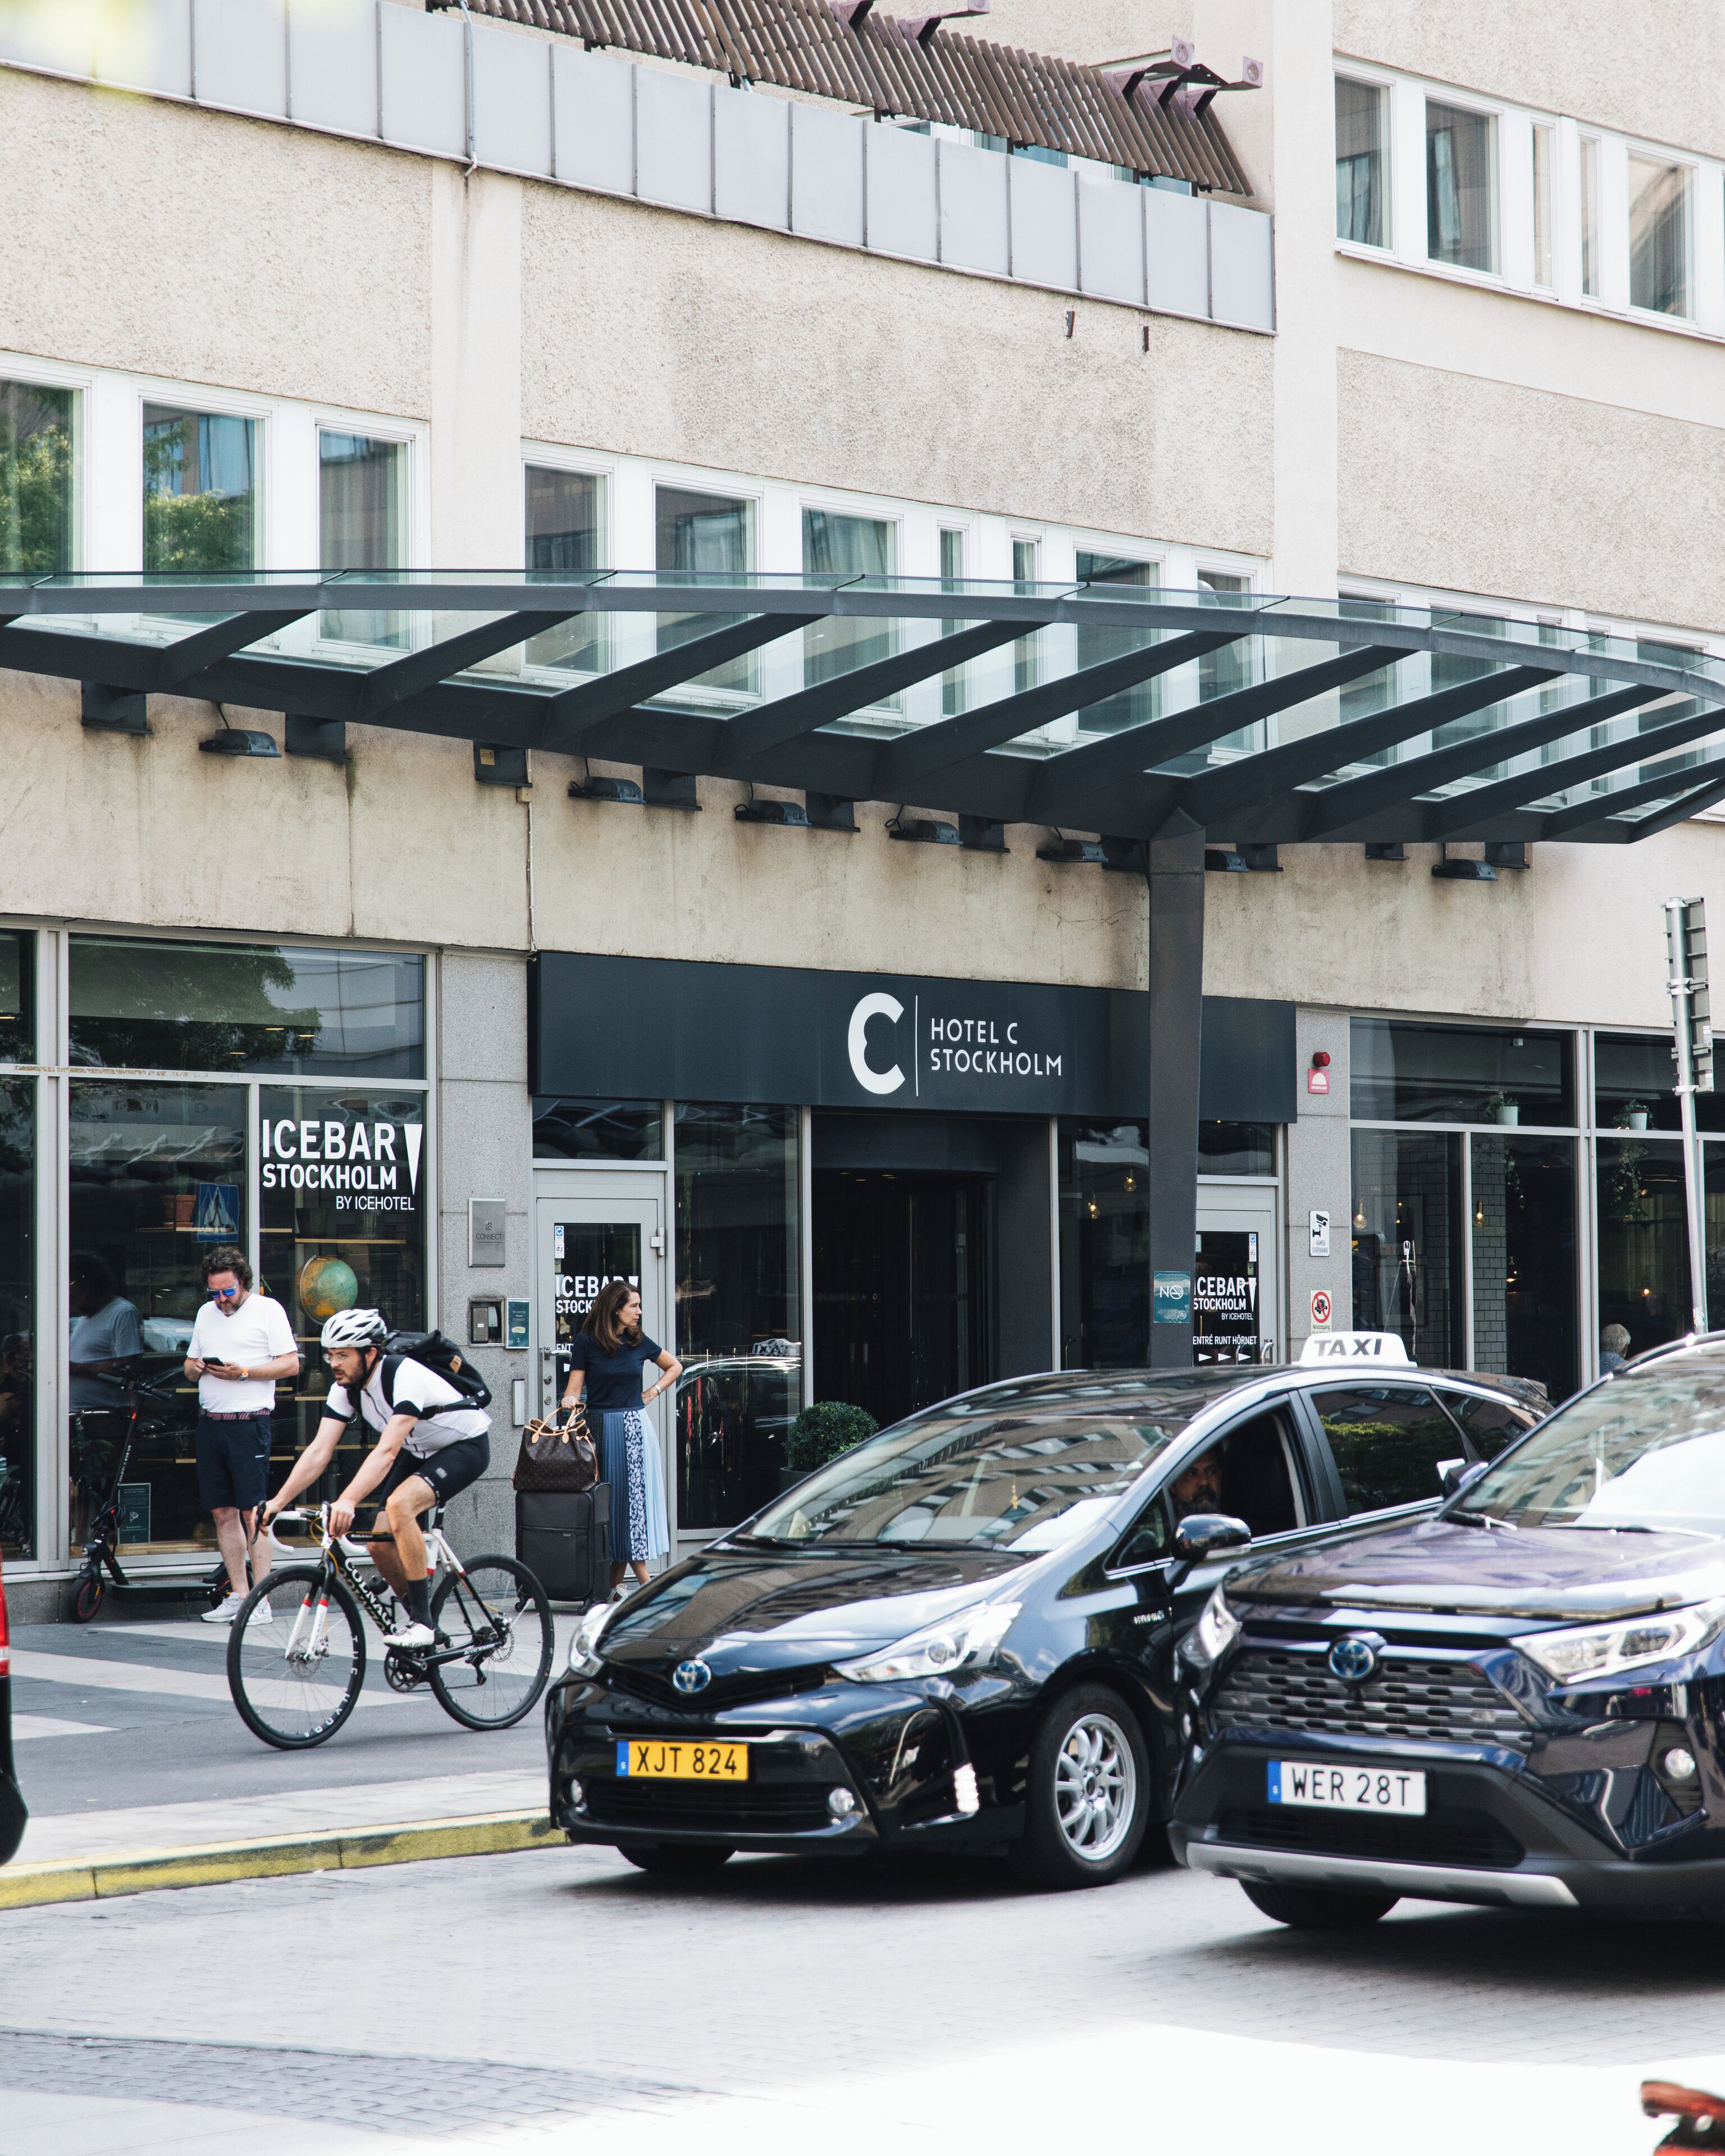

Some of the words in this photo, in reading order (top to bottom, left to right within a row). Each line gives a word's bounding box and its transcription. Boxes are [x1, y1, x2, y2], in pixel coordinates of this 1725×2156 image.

[847, 992, 906, 1095] C
[931, 1018, 999, 1044] HOTEL
[1007, 1022, 1018, 1044] C
[930, 1048, 1062, 1076] STOCKHOLM
[262, 1119, 396, 1161] ICEBAR
[262, 1163, 396, 1190] STOCKHOLM
[336, 1196, 352, 1209] BY
[355, 1196, 415, 1211] ICEHOTEL
[556, 1299, 596, 1313] STOCK
[556, 1343, 574, 1352] ENT
[1193, 1334, 1213, 1345] ENTRÉ
[1215, 1336, 1231, 1345] RUNT
[1233, 1335, 1257, 1345] HÖRNET
[1314, 1338, 1382, 1356] TAXI
[620, 1761, 626, 1770] S
[637, 1746, 682, 1773] XJT
[693, 1747, 737, 1775] 824
[1272, 1785, 1279, 1794] S
[1292, 1766, 1345, 1801] WER
[1357, 1772, 1411, 1806] 28T
